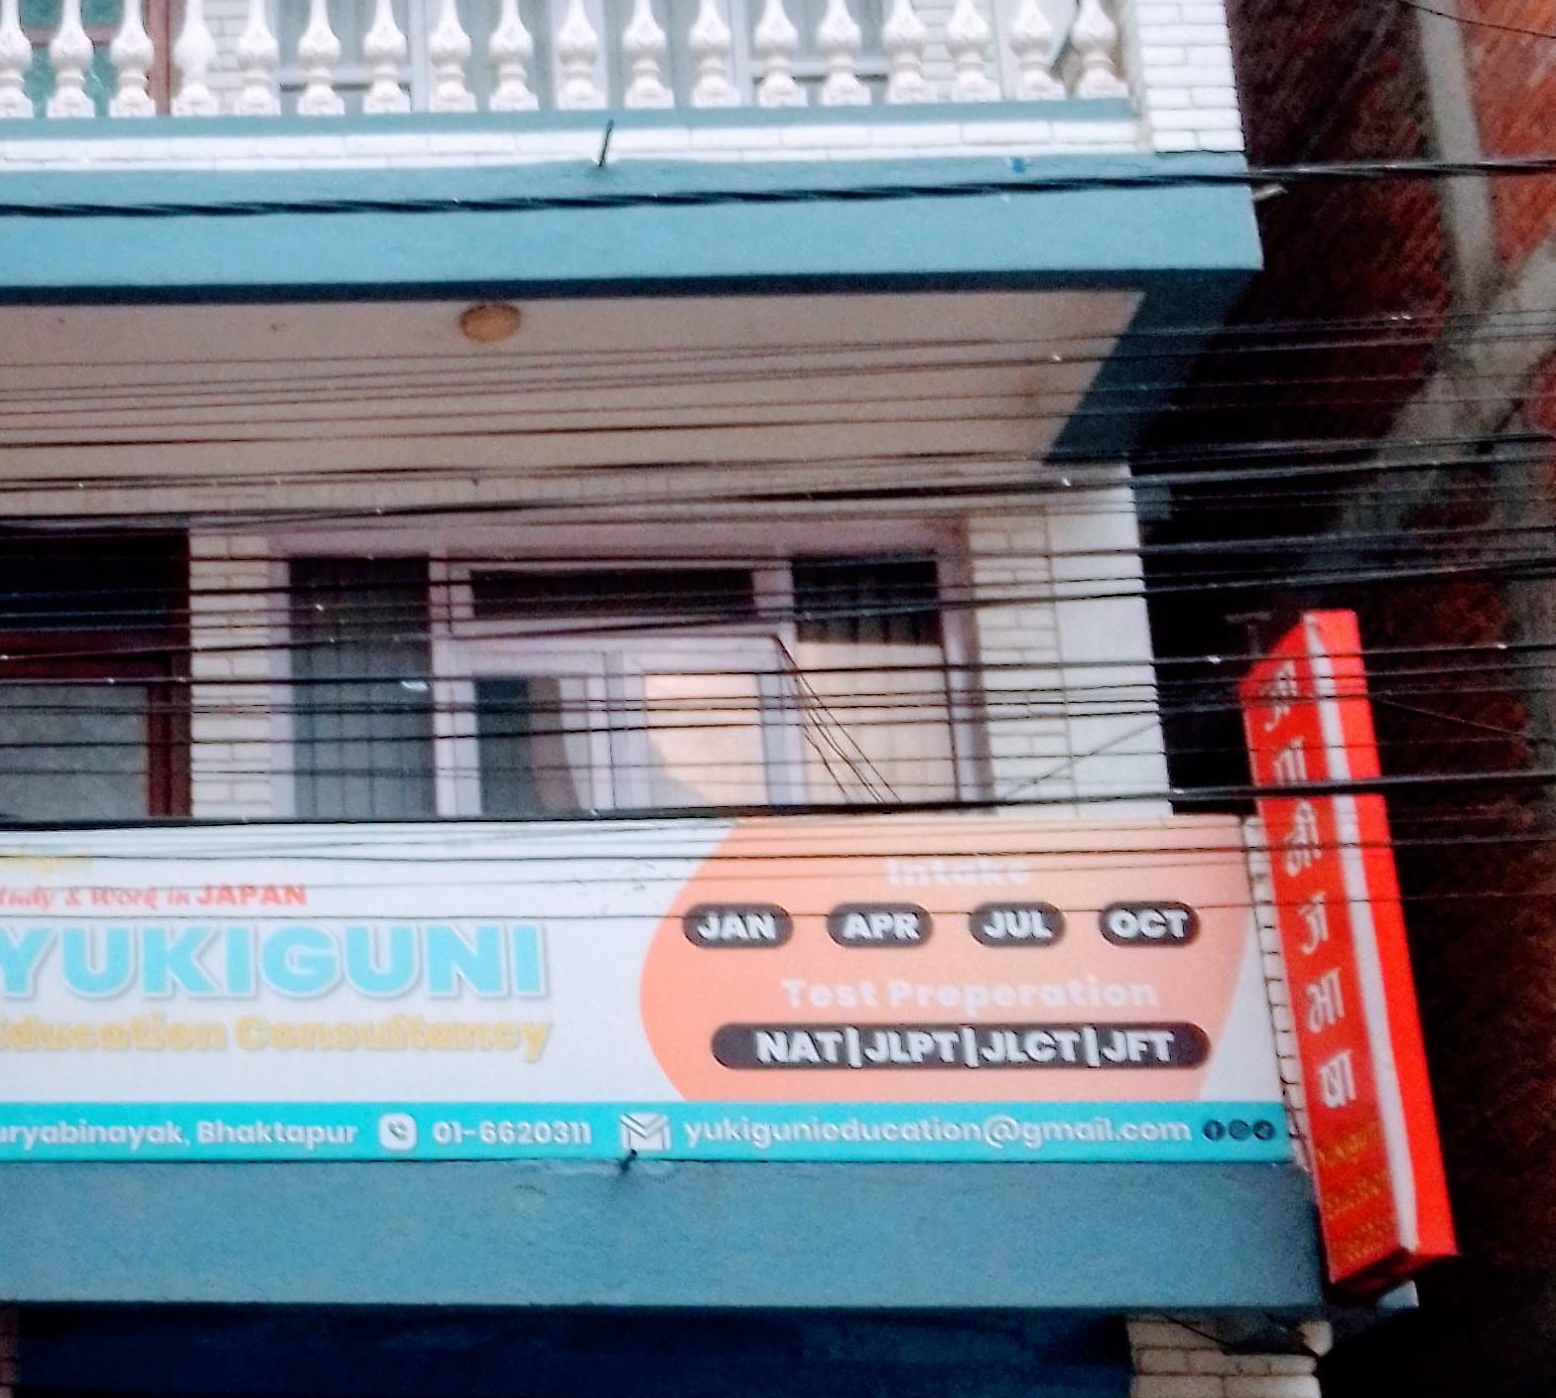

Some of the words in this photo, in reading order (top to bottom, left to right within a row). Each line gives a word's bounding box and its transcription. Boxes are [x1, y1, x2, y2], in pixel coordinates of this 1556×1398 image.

[884, 858, 1032, 886] Intake
[197, 883, 307, 907] JAPAN
[696, 910, 777, 941] JAN
[842, 910, 922, 941] APR
[982, 910, 1053, 940] JUL
[1107, 909, 1190, 940] OCT
[780, 976, 879, 1009] Test
[234, 1014, 554, 1063] Consultancy
[196, 1118, 359, 1154] Bhaktapur
[432, 1119, 593, 1146] 01-6620311
